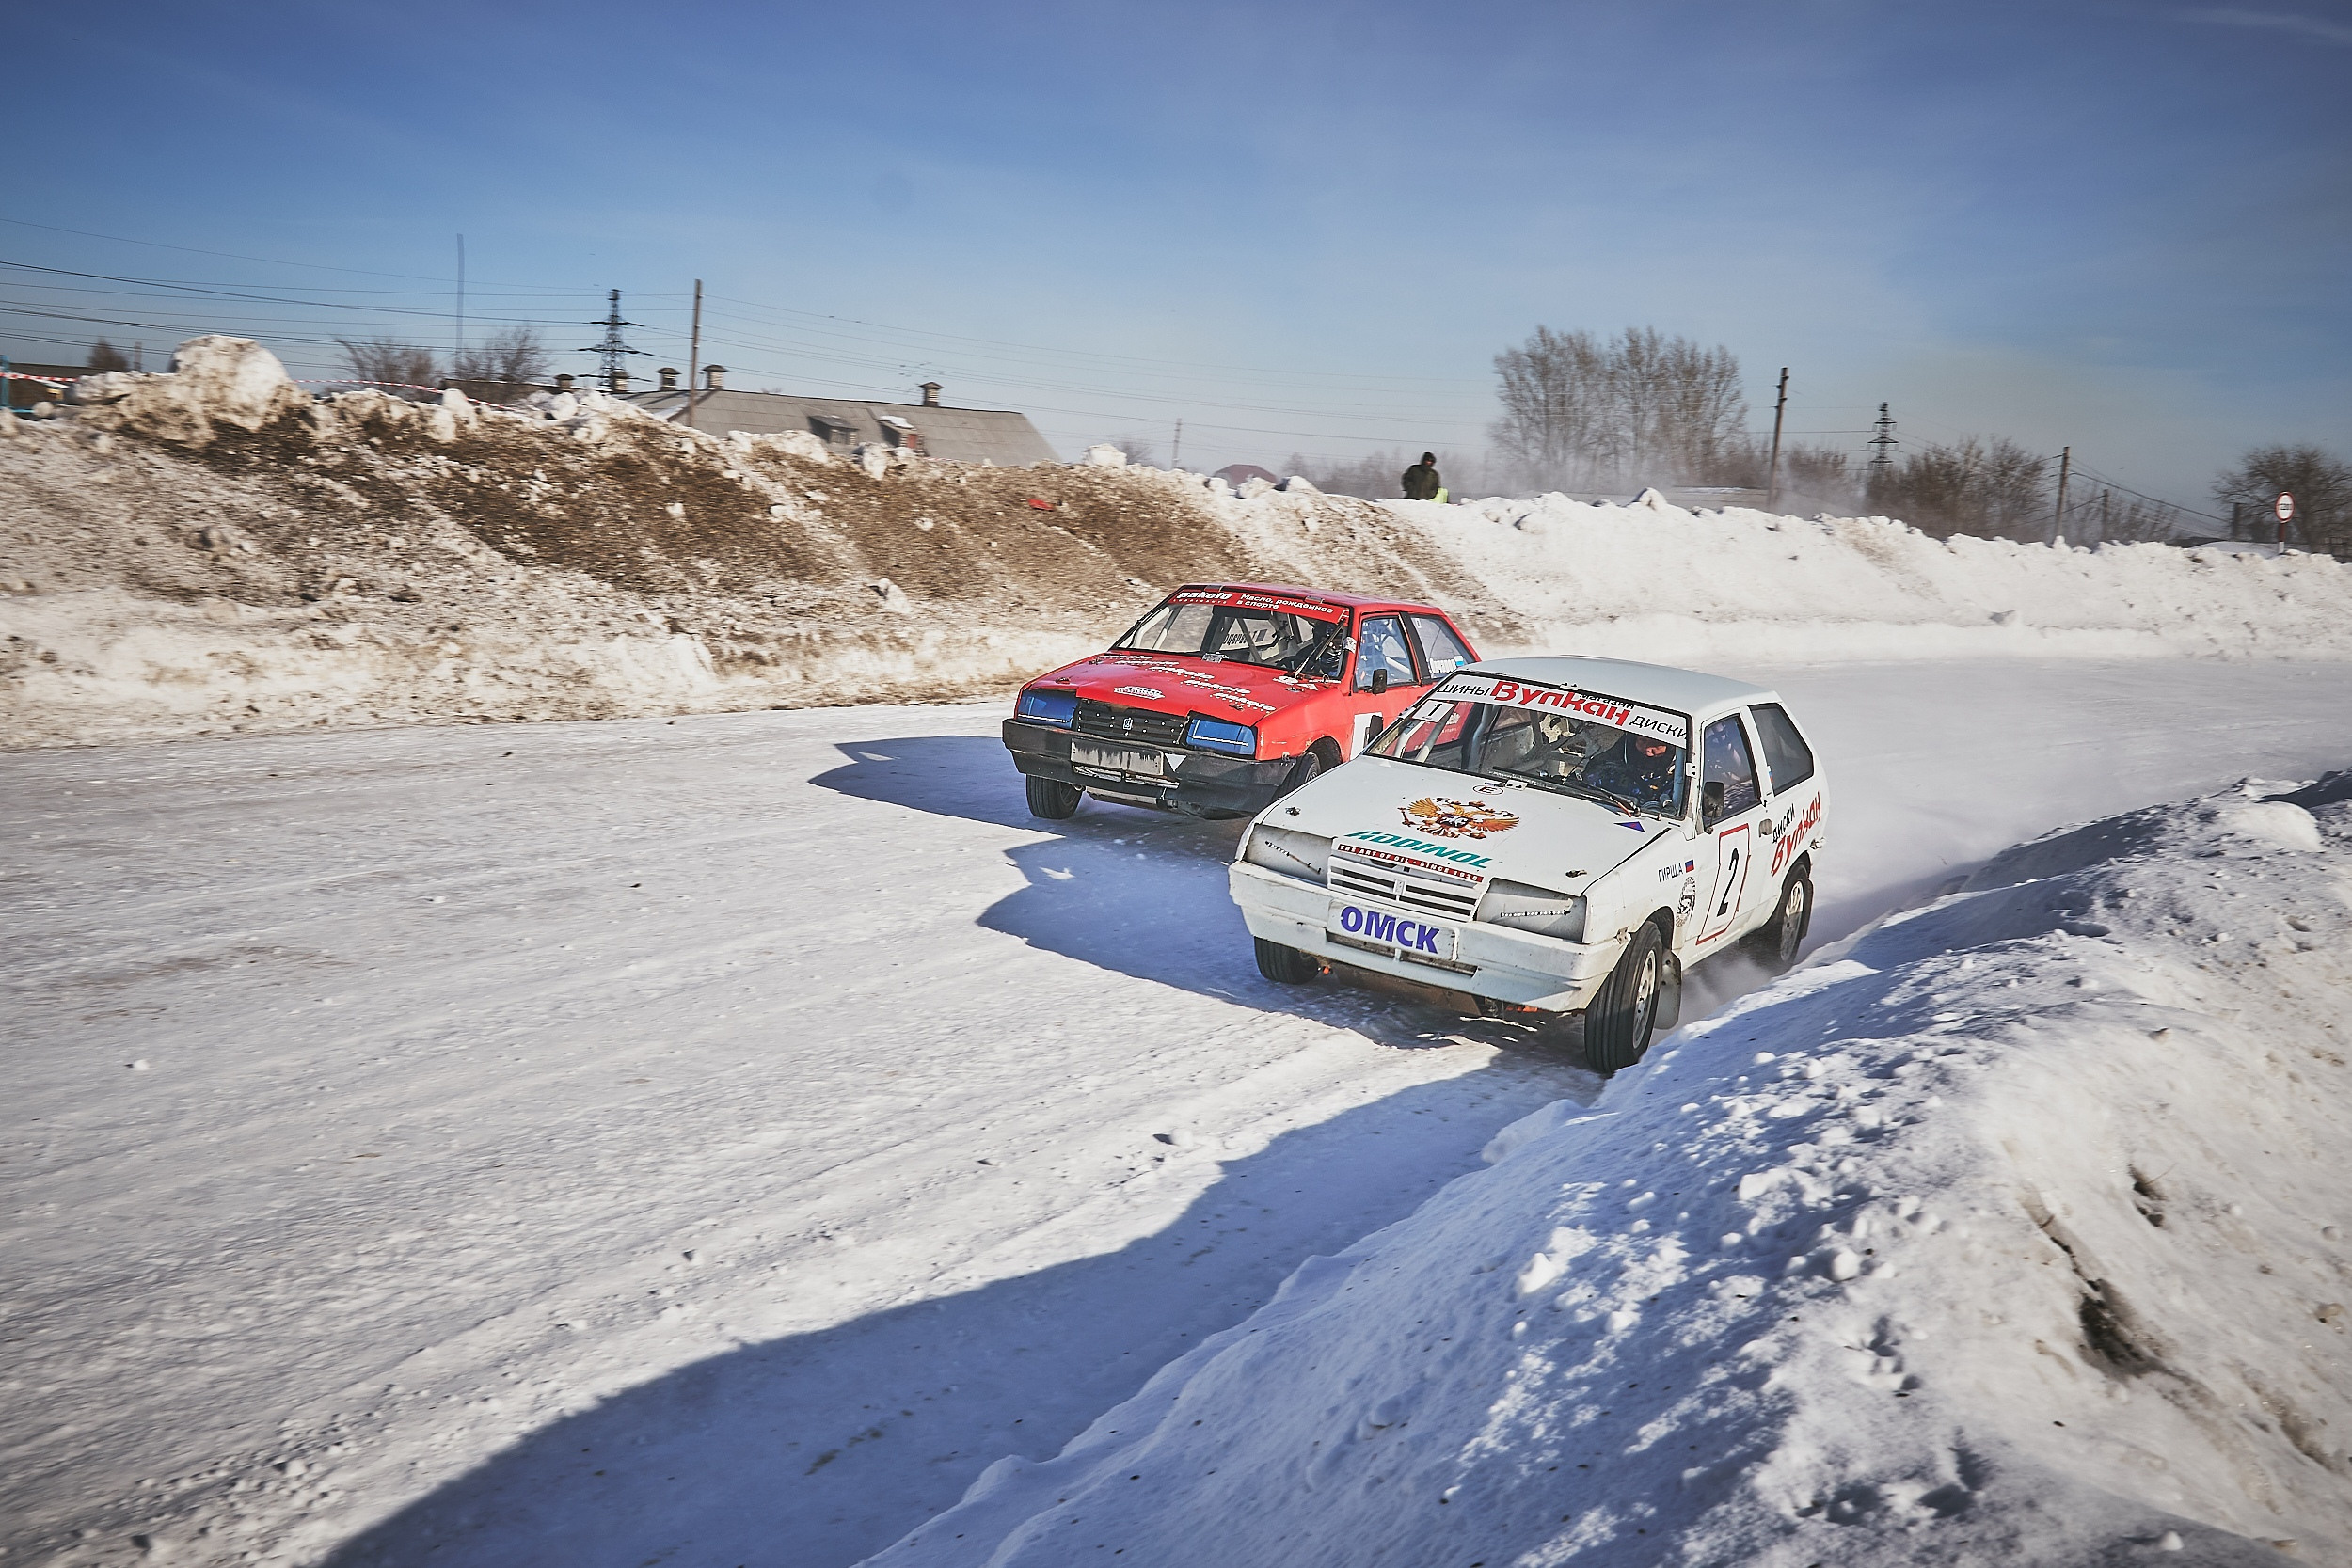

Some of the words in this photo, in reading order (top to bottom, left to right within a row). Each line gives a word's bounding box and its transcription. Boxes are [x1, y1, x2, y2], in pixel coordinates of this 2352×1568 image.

[1427, 703, 1443, 717] 1
[1420, 862, 1450, 872] SINCE
[1716, 847, 1740, 917] 2
[1340, 906, 1440, 955] ОМСК
